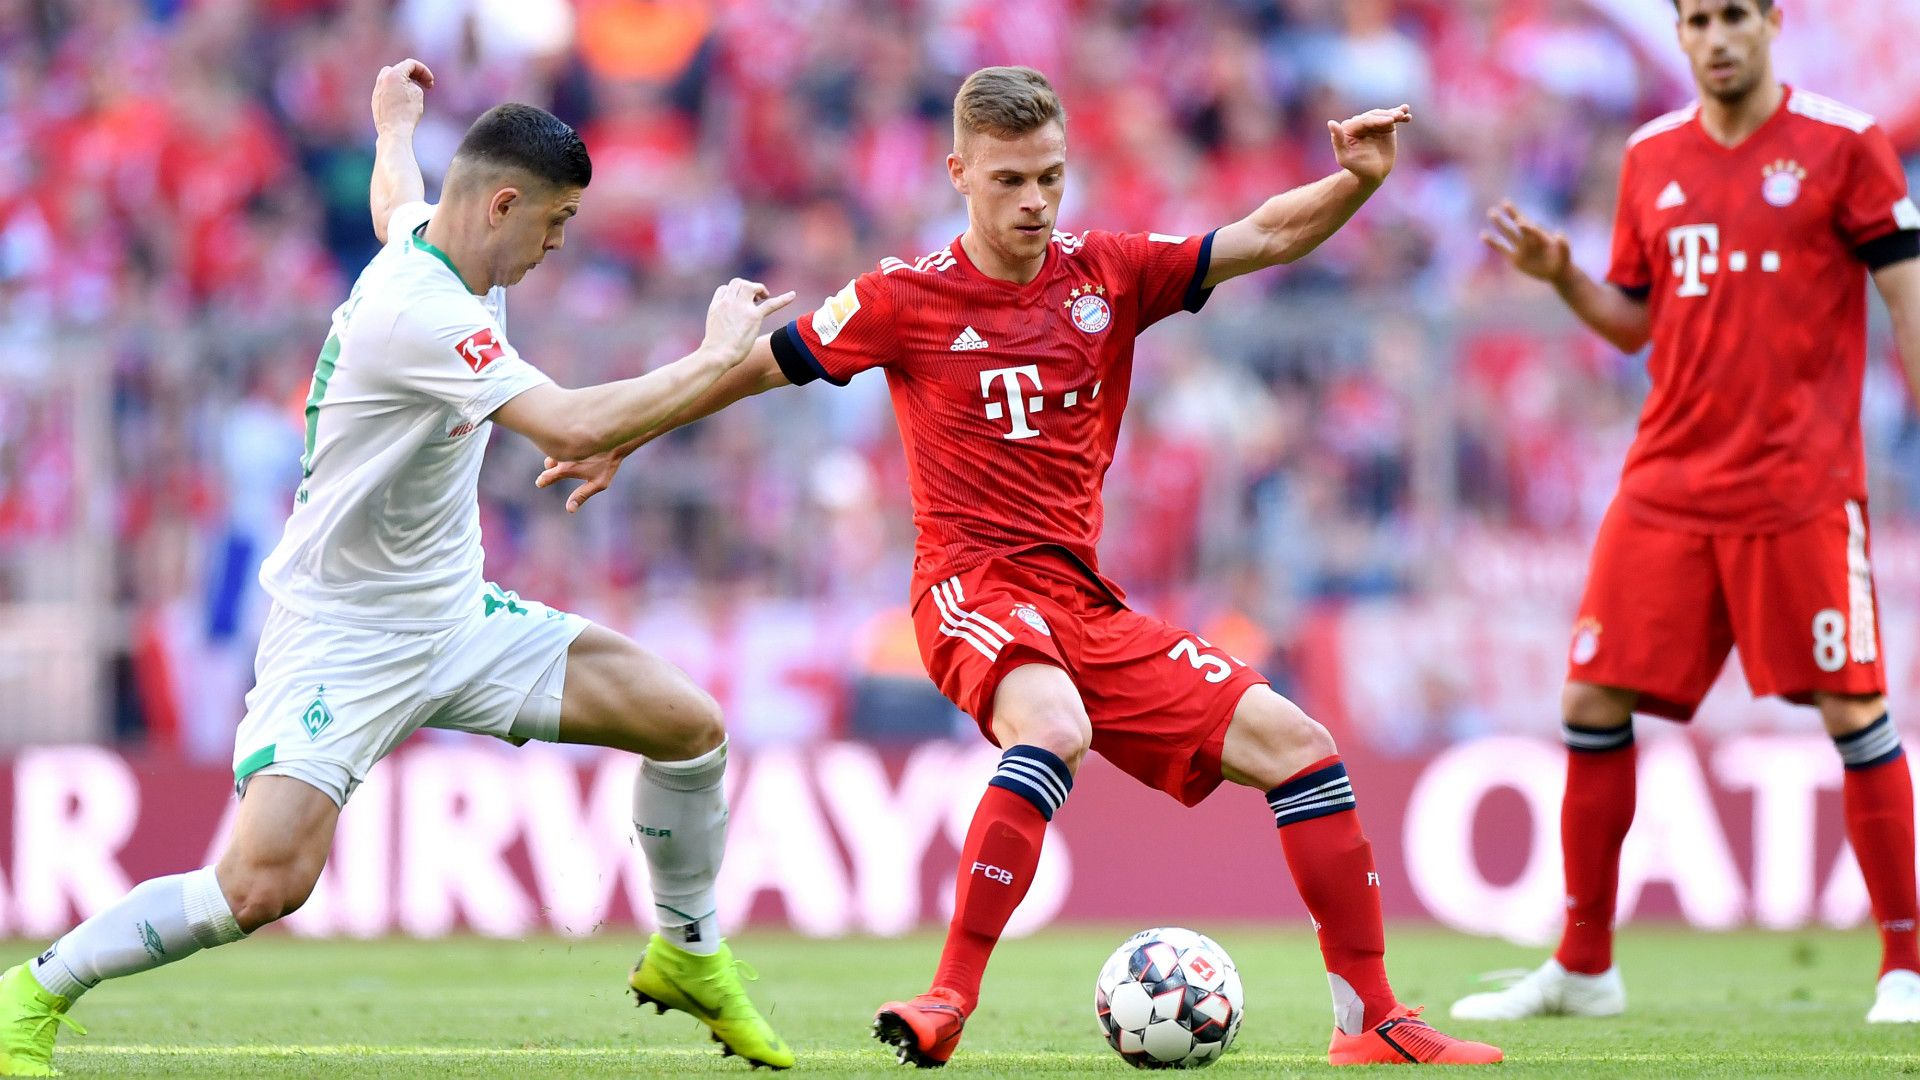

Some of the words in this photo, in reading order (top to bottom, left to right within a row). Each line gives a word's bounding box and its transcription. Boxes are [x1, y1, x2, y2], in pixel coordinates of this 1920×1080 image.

[950, 340, 989, 352] adidas
[1167, 635, 1247, 683] 3
[1812, 608, 1848, 673] 8
[0, 742, 139, 940] R
[203, 738, 1075, 940] IRWAYS
[1403, 734, 1920, 946] QAT
[970, 861, 1014, 885] FCB
